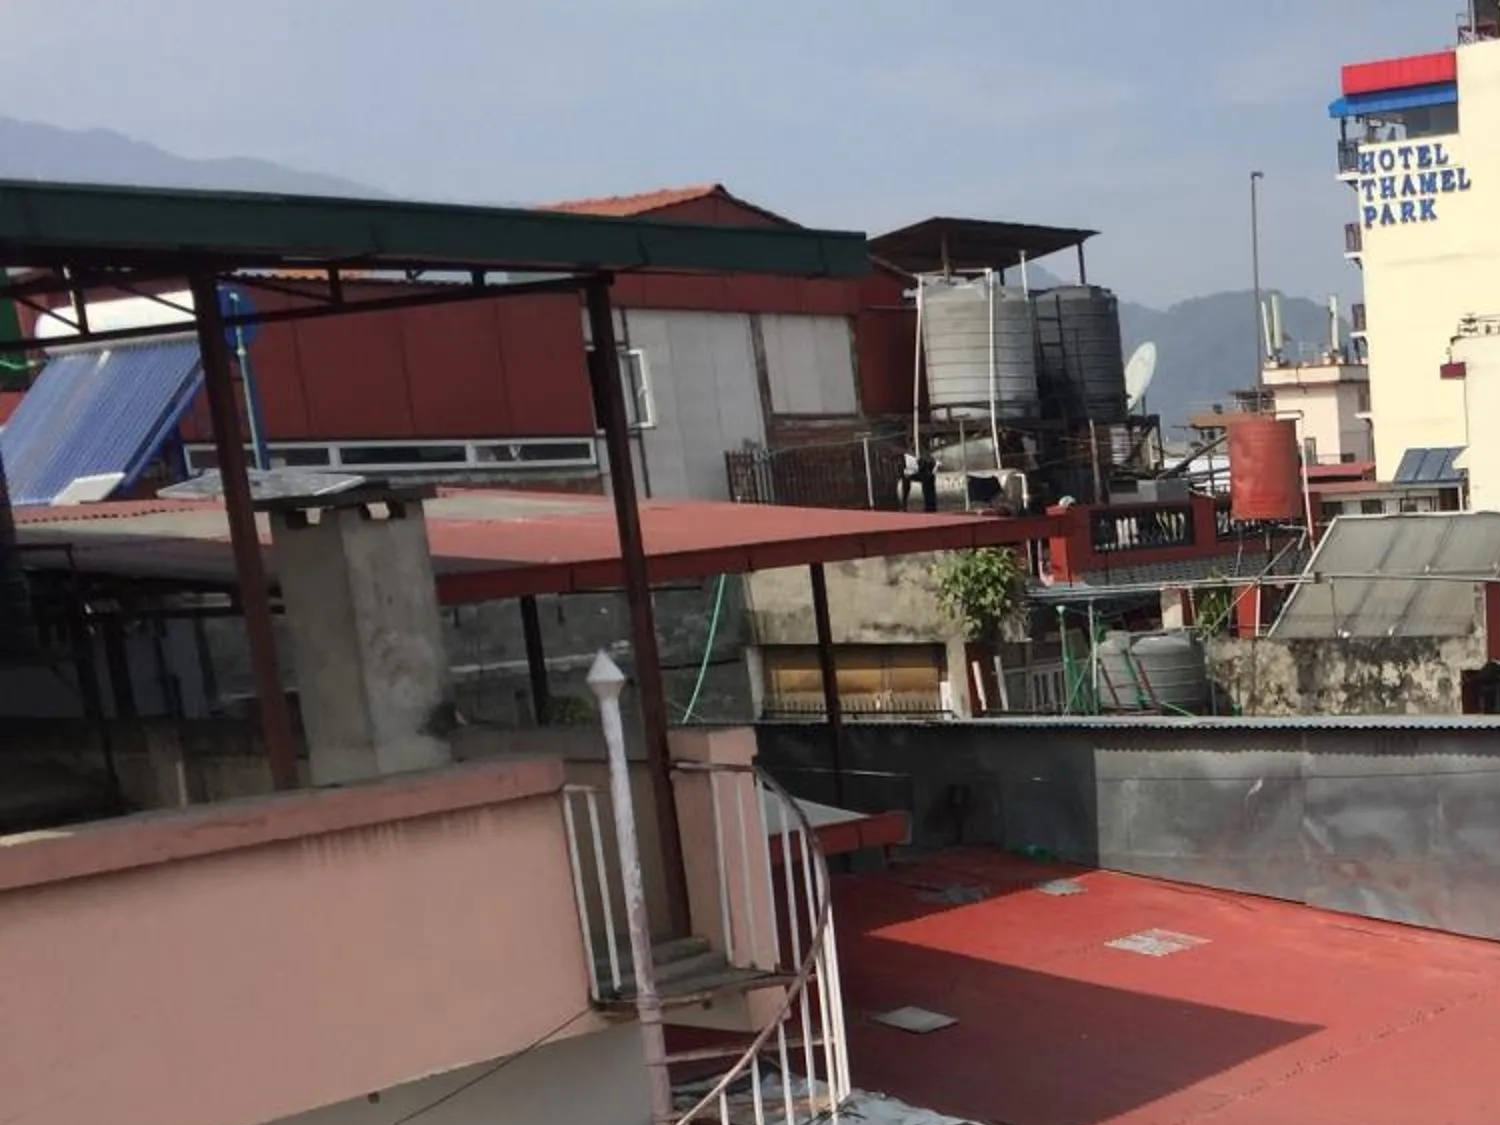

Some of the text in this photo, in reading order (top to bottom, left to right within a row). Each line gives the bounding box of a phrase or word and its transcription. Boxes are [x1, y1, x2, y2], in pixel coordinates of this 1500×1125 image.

[1358, 143, 1449, 174] HOTEL
[1361, 167, 1472, 201] THAMEL
[1363, 198, 1437, 229] PARK
